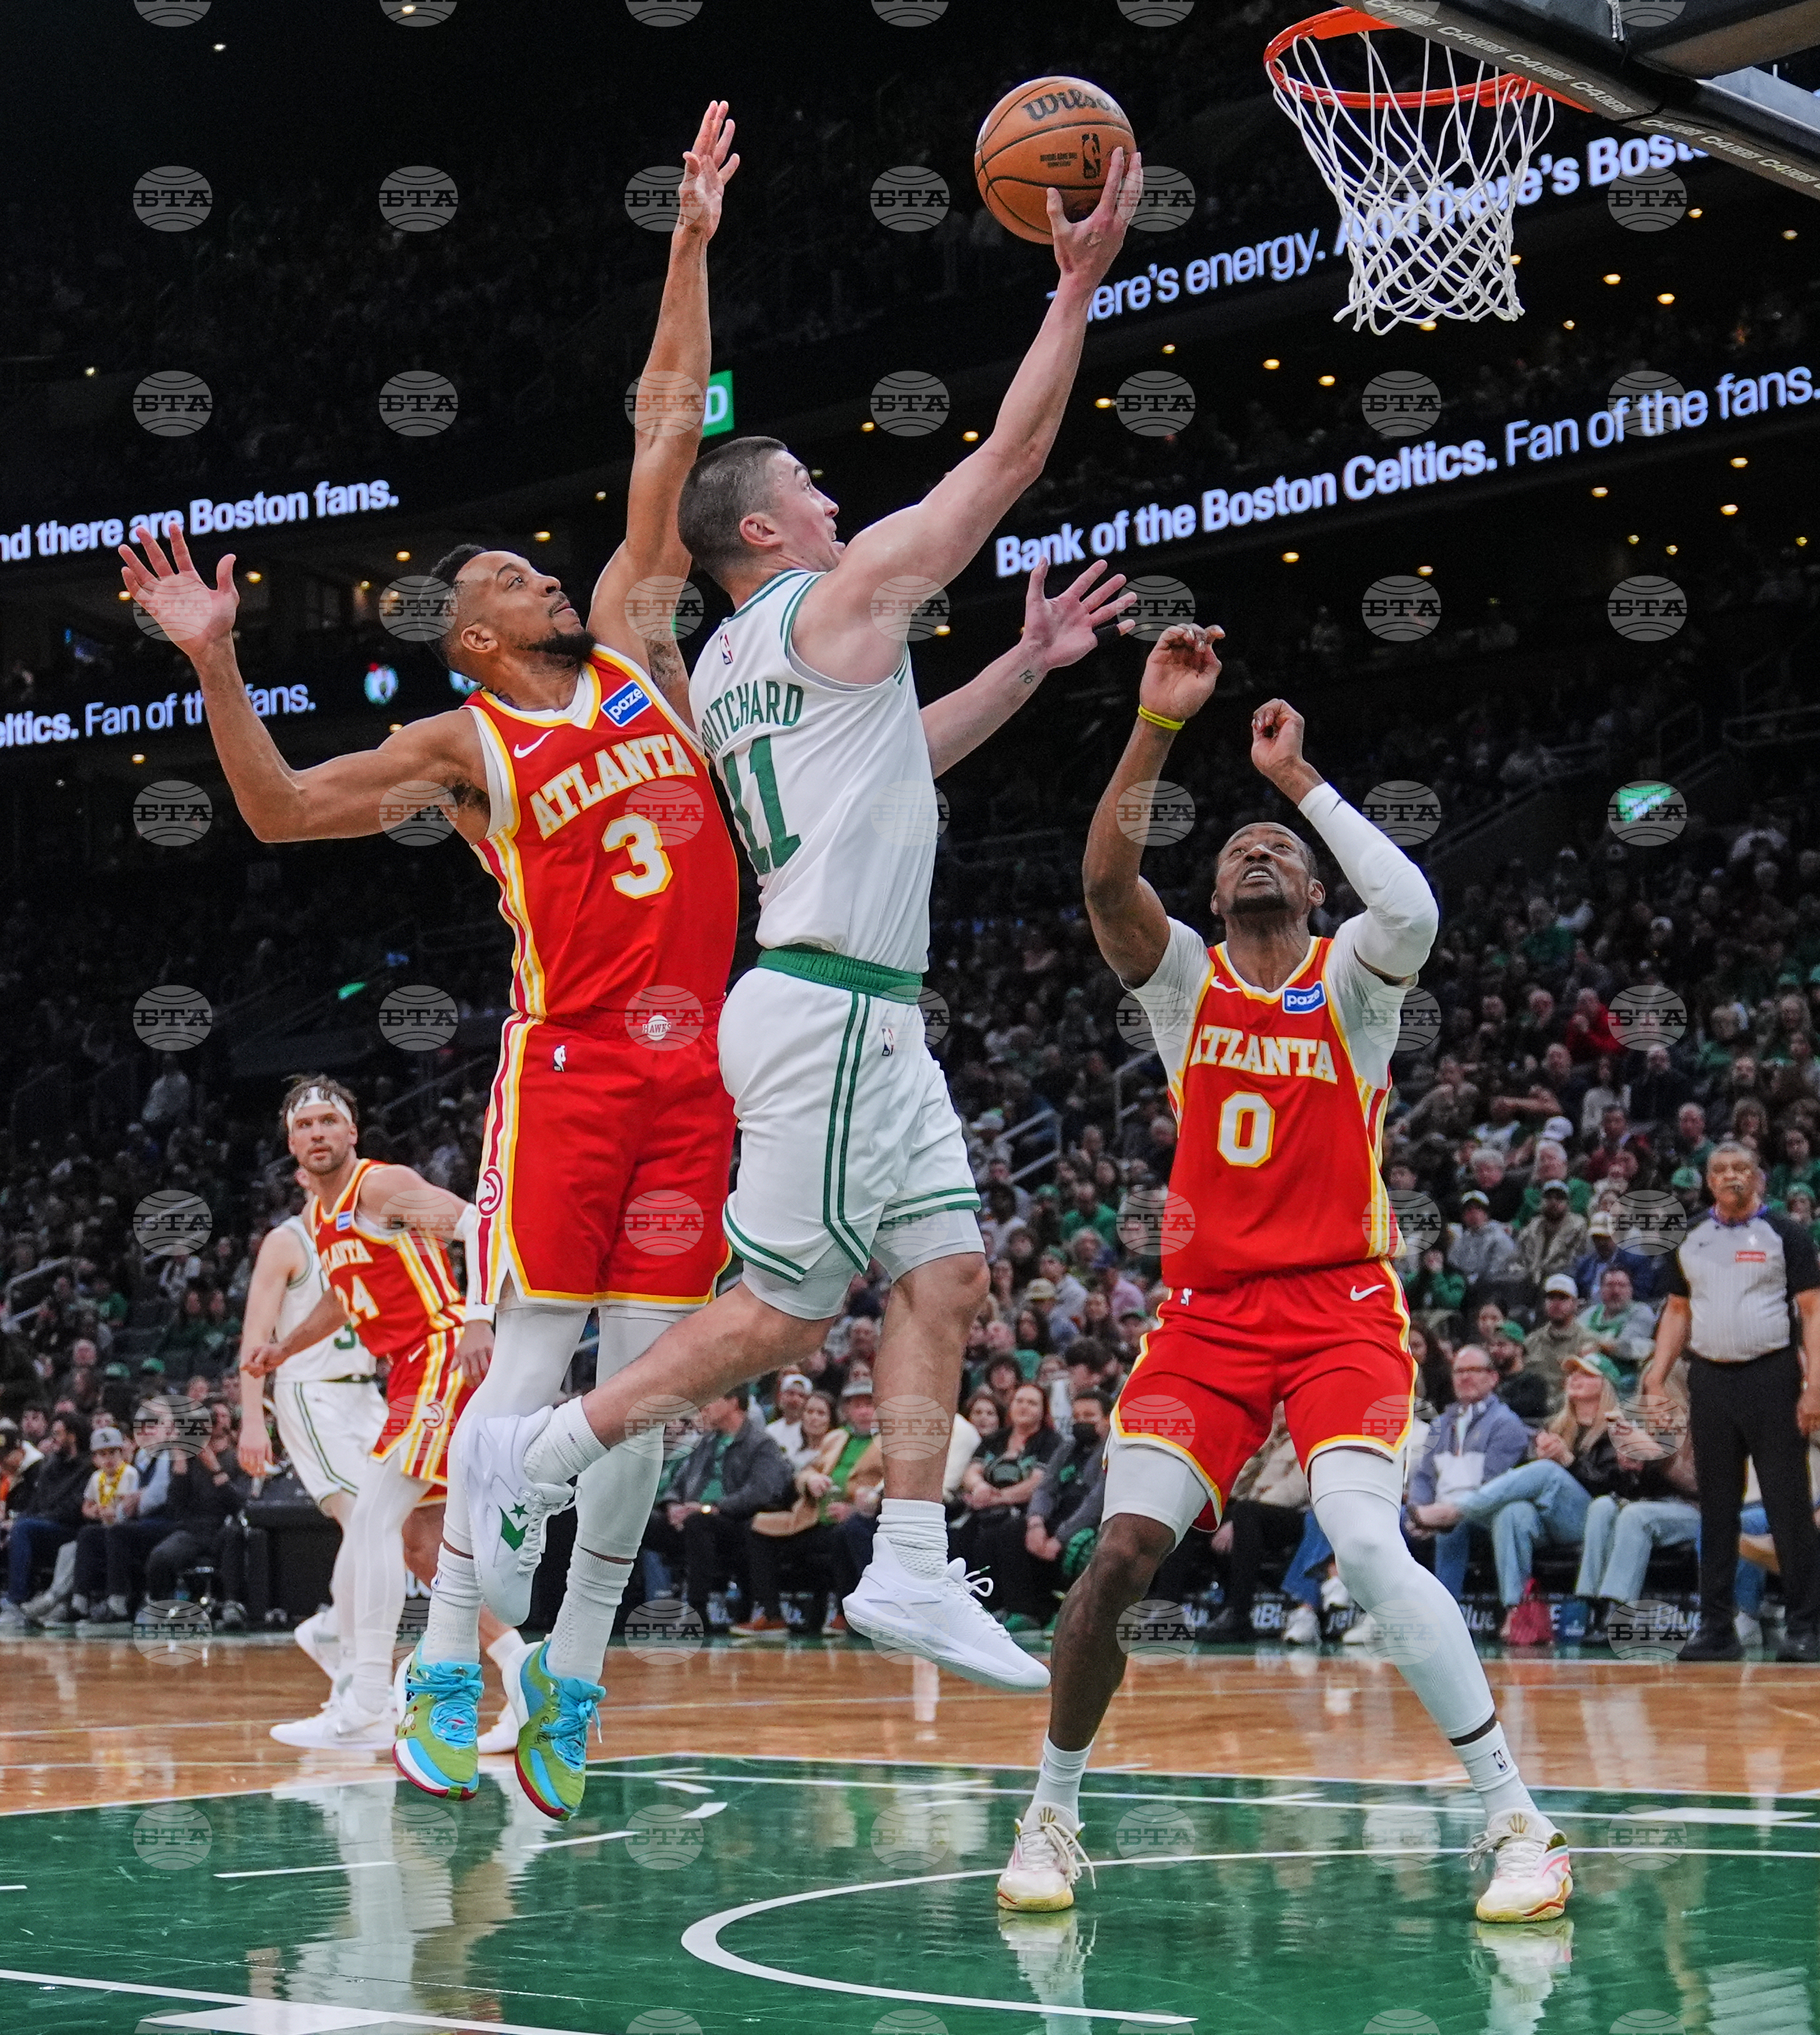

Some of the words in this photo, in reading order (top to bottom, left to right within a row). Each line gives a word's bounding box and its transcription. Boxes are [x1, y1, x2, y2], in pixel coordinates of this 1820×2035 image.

[1595, 94, 1636, 114] ENERGY
[1185, 227, 1326, 295] energy.
[705, 384, 728, 424] D
[995, 523, 1084, 578] Bank
[1092, 509, 1130, 556] of
[1134, 502, 1196, 546] the
[1202, 472, 1337, 533] Boston
[1343, 439, 1498, 502] Celtics.
[1505, 418, 1580, 466] Fan
[1587, 397, 1630, 449] of
[1638, 388, 1708, 437] the
[1714, 366, 1820, 421] fans.
[35, 519, 124, 557] there
[128, 510, 184, 544] are
[189, 491, 309, 536] Boston
[313, 479, 400, 518] fans.
[85, 702, 140, 737] Fan
[145, 692, 177, 730] of
[608, 687, 644, 720] paze
[529, 733, 698, 841] ATLANTA
[722, 733, 802, 876] 11
[601, 812, 674, 900] 3
[642, 1021, 672, 1034] HAWKS
[1286, 988, 1320, 1007] paze
[1217, 1090, 1276, 1169] 0
